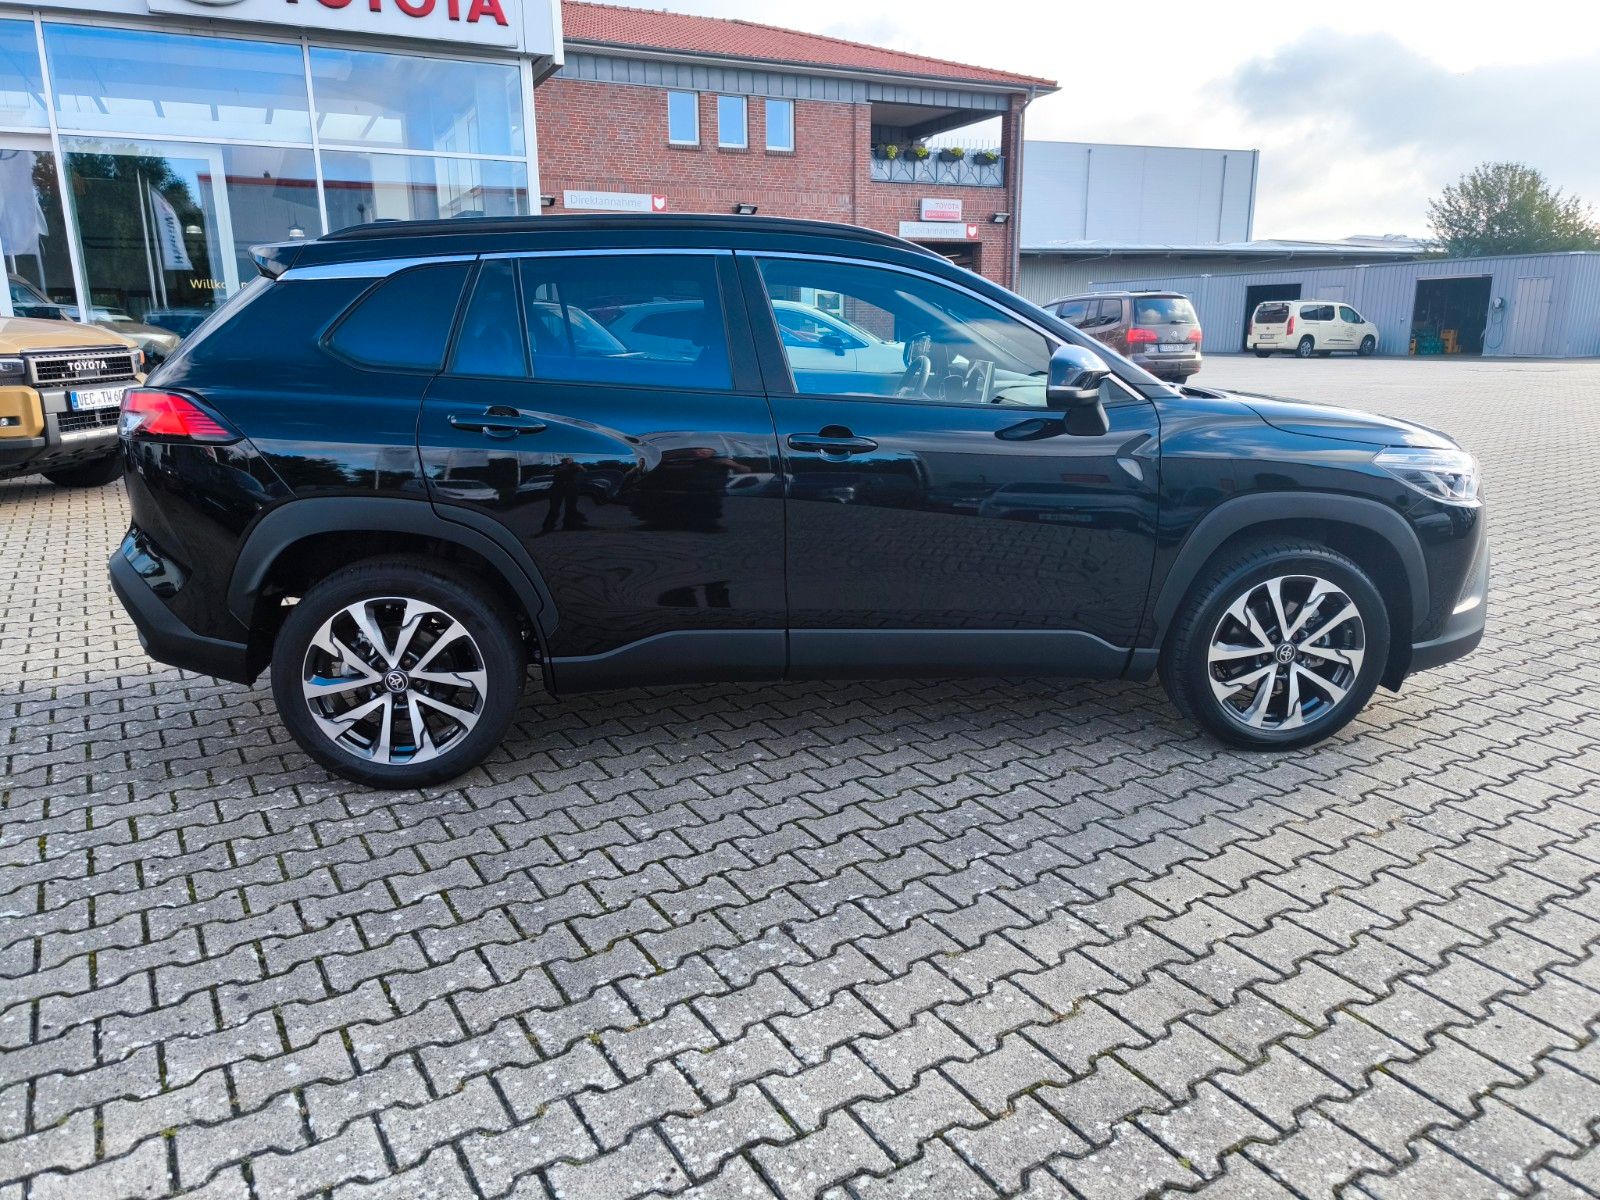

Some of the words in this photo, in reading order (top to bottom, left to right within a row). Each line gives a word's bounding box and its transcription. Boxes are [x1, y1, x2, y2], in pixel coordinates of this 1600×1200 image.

[286, 0, 508, 26] OTA
[570, 194, 643, 208] Direktannahme
[67, 360, 107, 371] TOYOTA
[77, 392, 96, 406] VEC
[100, 391, 112, 403] TW
